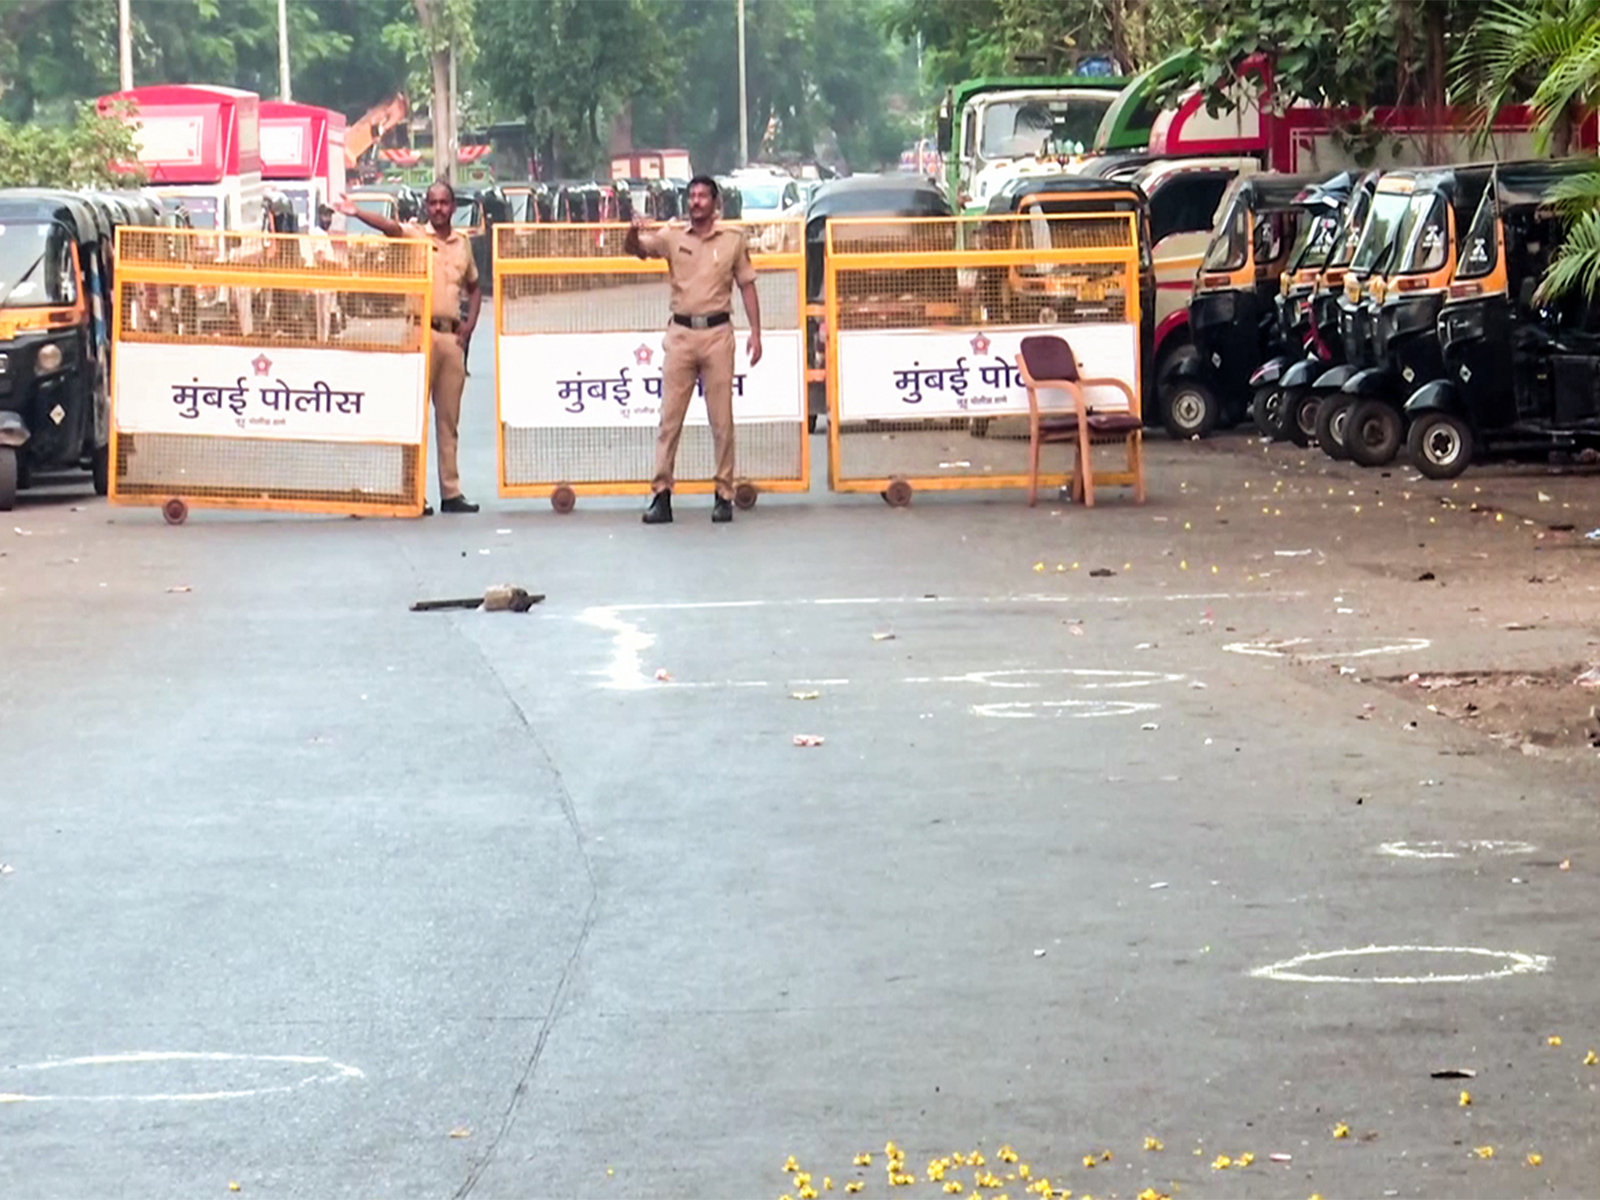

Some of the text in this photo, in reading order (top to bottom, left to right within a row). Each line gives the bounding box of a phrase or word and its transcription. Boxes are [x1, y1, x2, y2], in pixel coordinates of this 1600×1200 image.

[171, 377, 365, 419] मुंबई पोलीस
[556, 367, 633, 413] मुंबई
[893, 357, 970, 403] मुंबई
